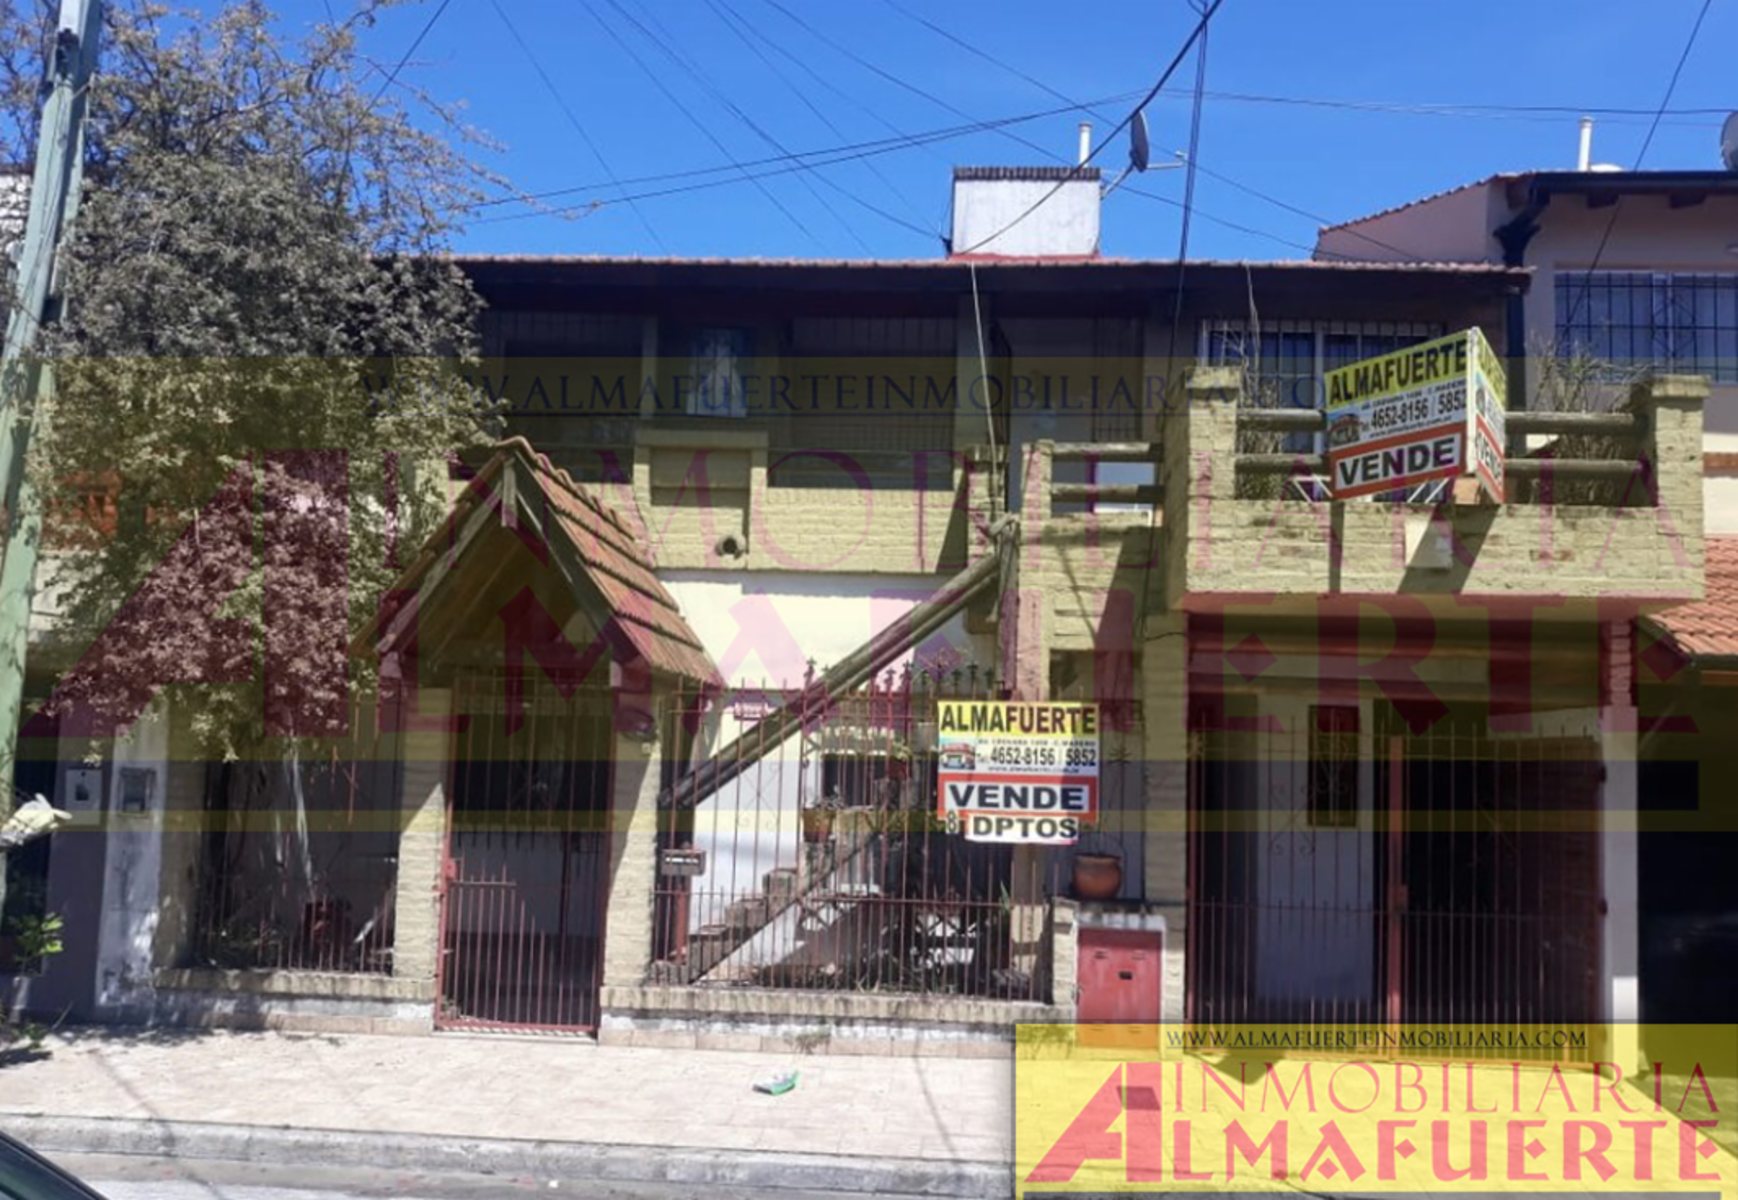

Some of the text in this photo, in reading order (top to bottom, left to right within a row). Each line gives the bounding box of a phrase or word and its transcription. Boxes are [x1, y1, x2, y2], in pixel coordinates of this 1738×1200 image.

[1330, 338, 1467, 405] ALMAFUERTE
[1370, 398, 1429, 430] 4652-8156
[1339, 437, 1455, 485] VENDE
[941, 705, 1096, 734] ALMAFUERTE
[990, 747, 1055, 766] 4652-8156
[1065, 748, 1096, 766] 5852
[949, 784, 1084, 810] VENDE
[973, 816, 1078, 838] DPTOS
